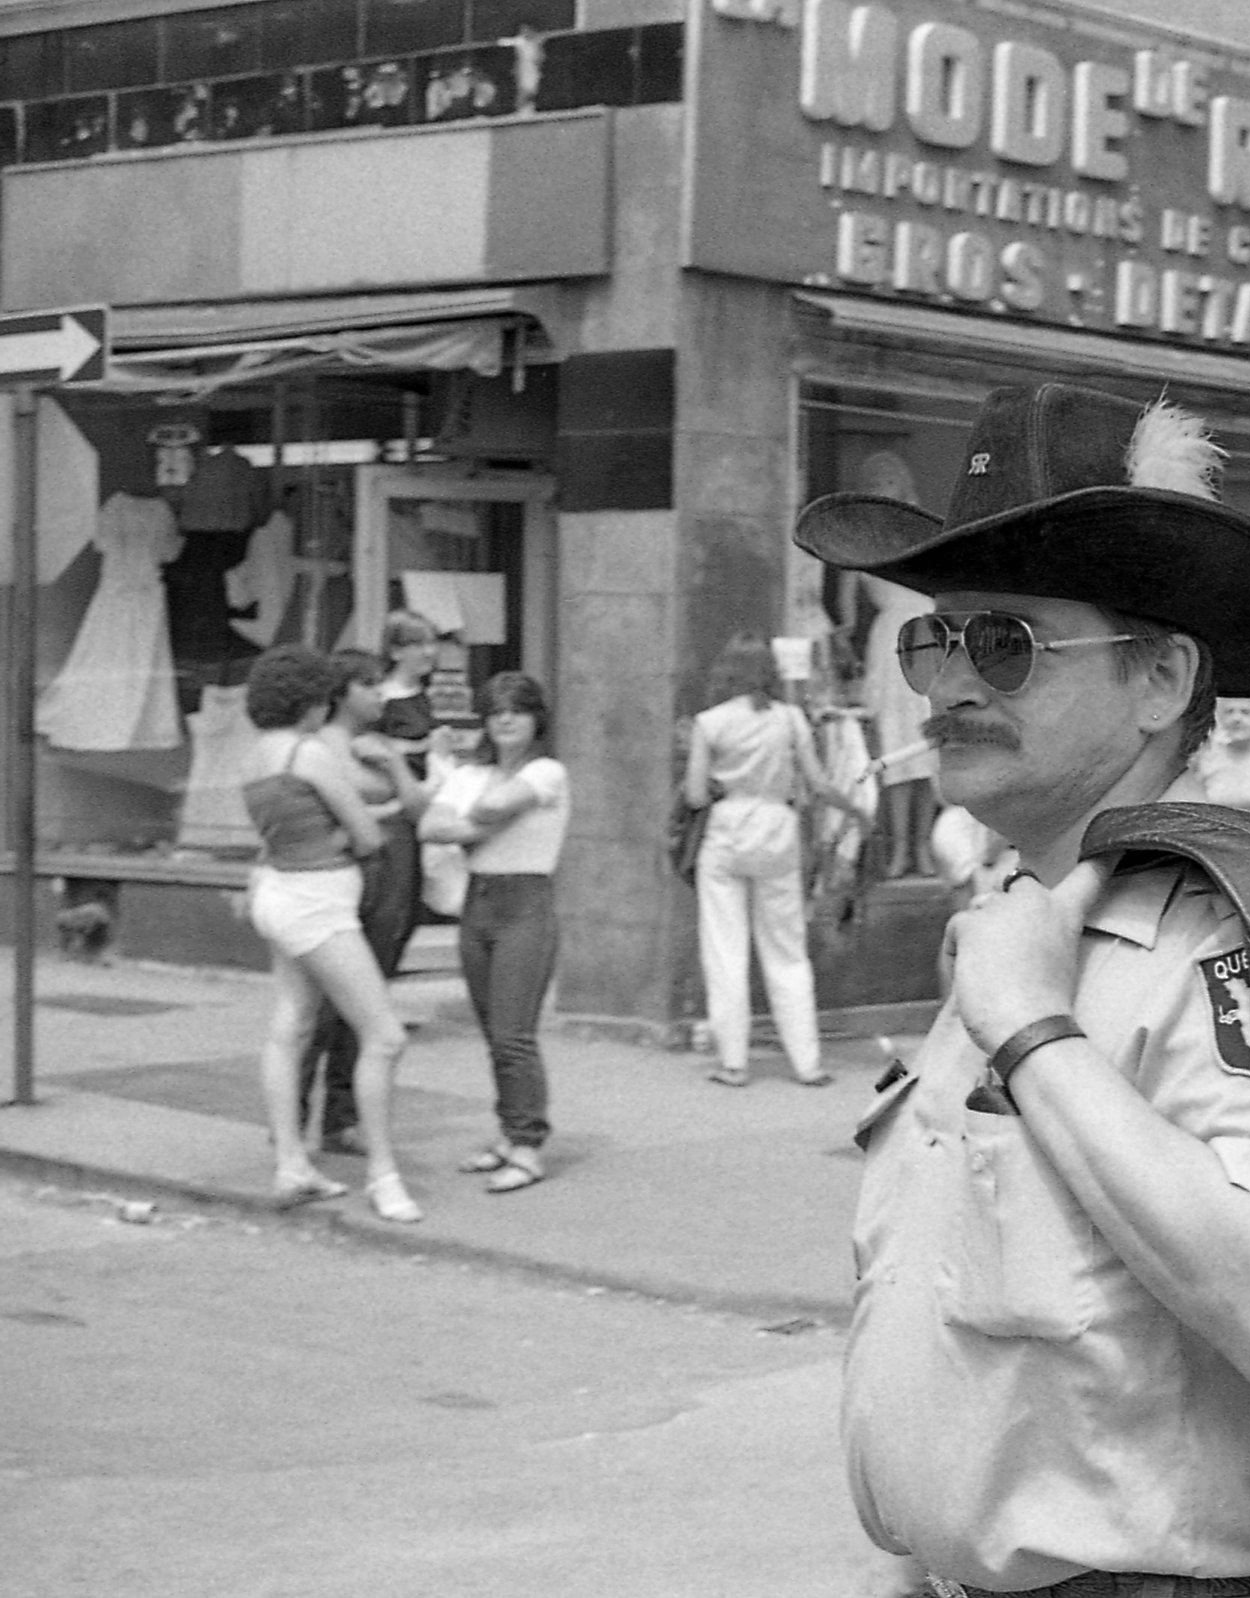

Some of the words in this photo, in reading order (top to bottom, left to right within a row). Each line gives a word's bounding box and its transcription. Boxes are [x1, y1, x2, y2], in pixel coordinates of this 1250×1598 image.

[801, 0, 1131, 182] MODE
[820, 142, 1144, 243] IMPORTATIONS
[1160, 208, 1211, 256] DE
